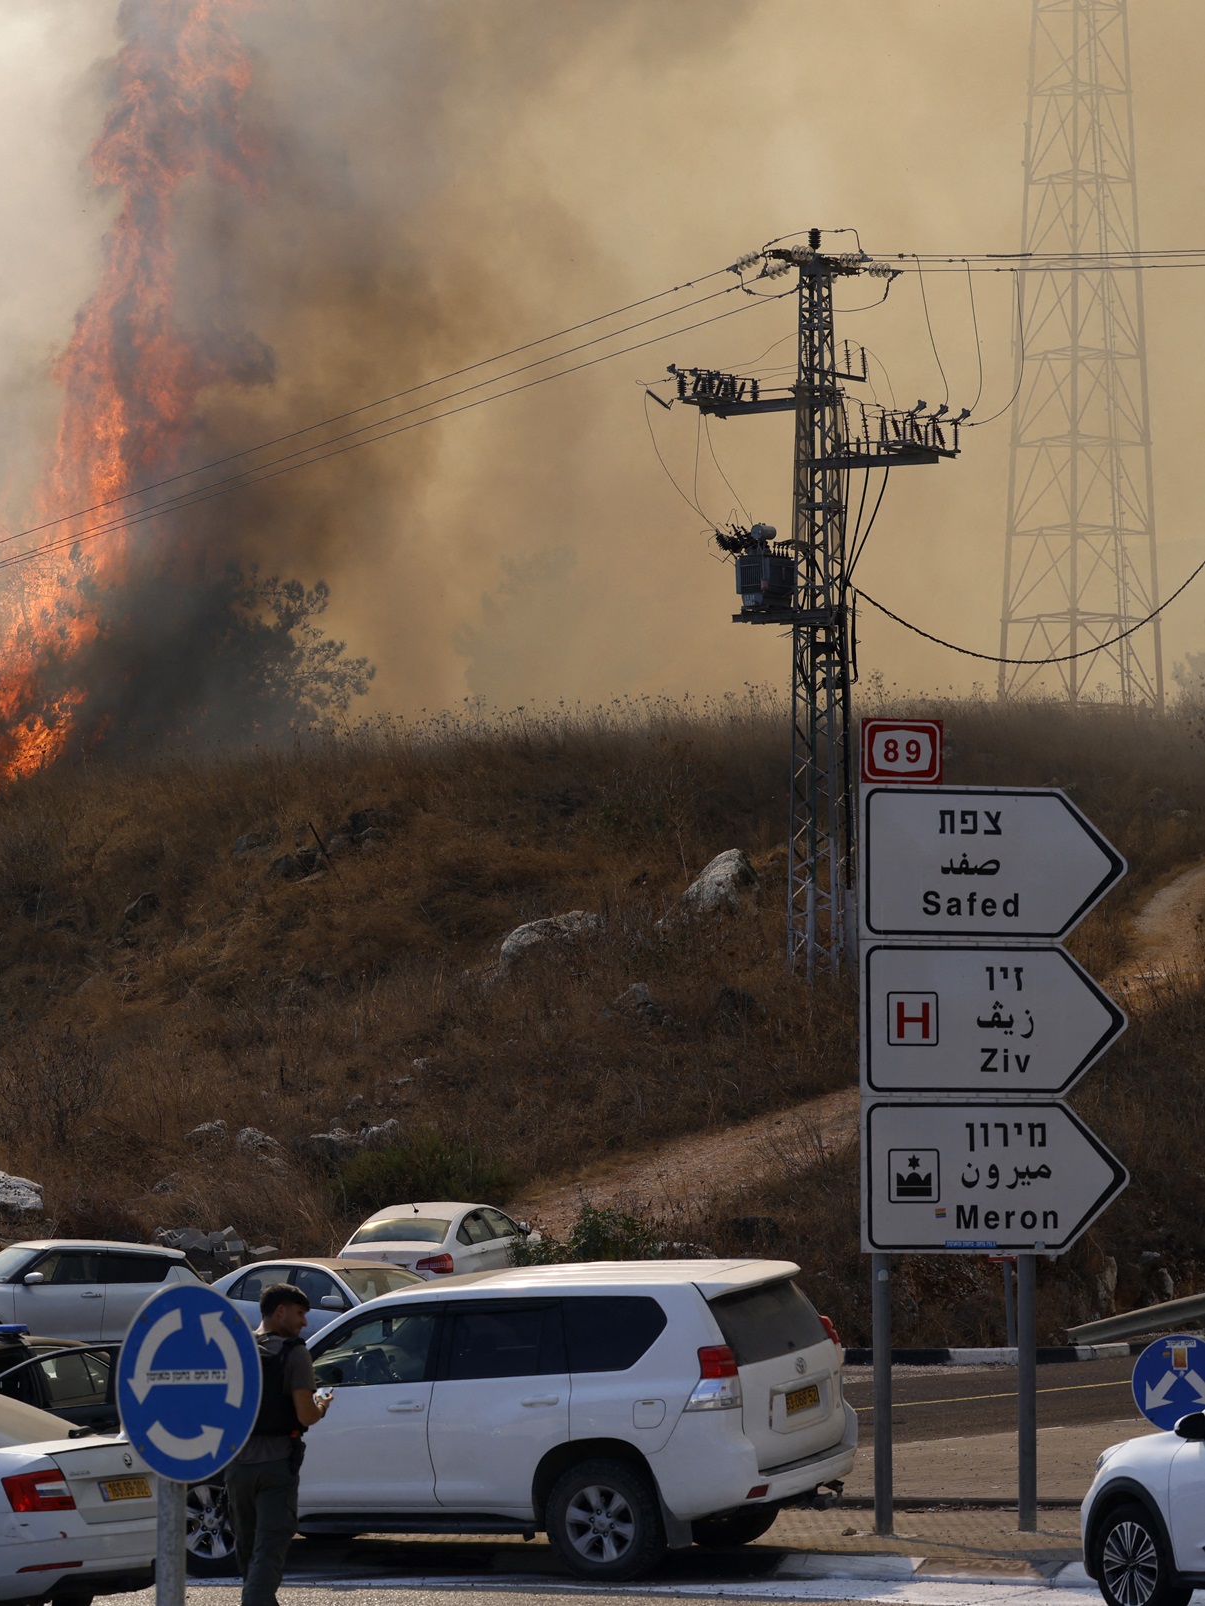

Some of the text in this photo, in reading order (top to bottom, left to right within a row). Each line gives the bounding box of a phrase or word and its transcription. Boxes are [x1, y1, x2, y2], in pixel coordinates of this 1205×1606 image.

[884, 739, 920, 763] 89
[939, 810, 1002, 835] צפת
[941, 852, 1000, 875] صفد
[922, 891, 1019, 917] Safed
[986, 967, 1023, 991] זיו
[897, 1002, 930, 1039] H
[980, 1048, 1030, 1073] Ziv
[965, 1123, 1046, 1152] מירון
[961, 1163, 1052, 1189] ميرون
[956, 1204, 1059, 1229] Meron
